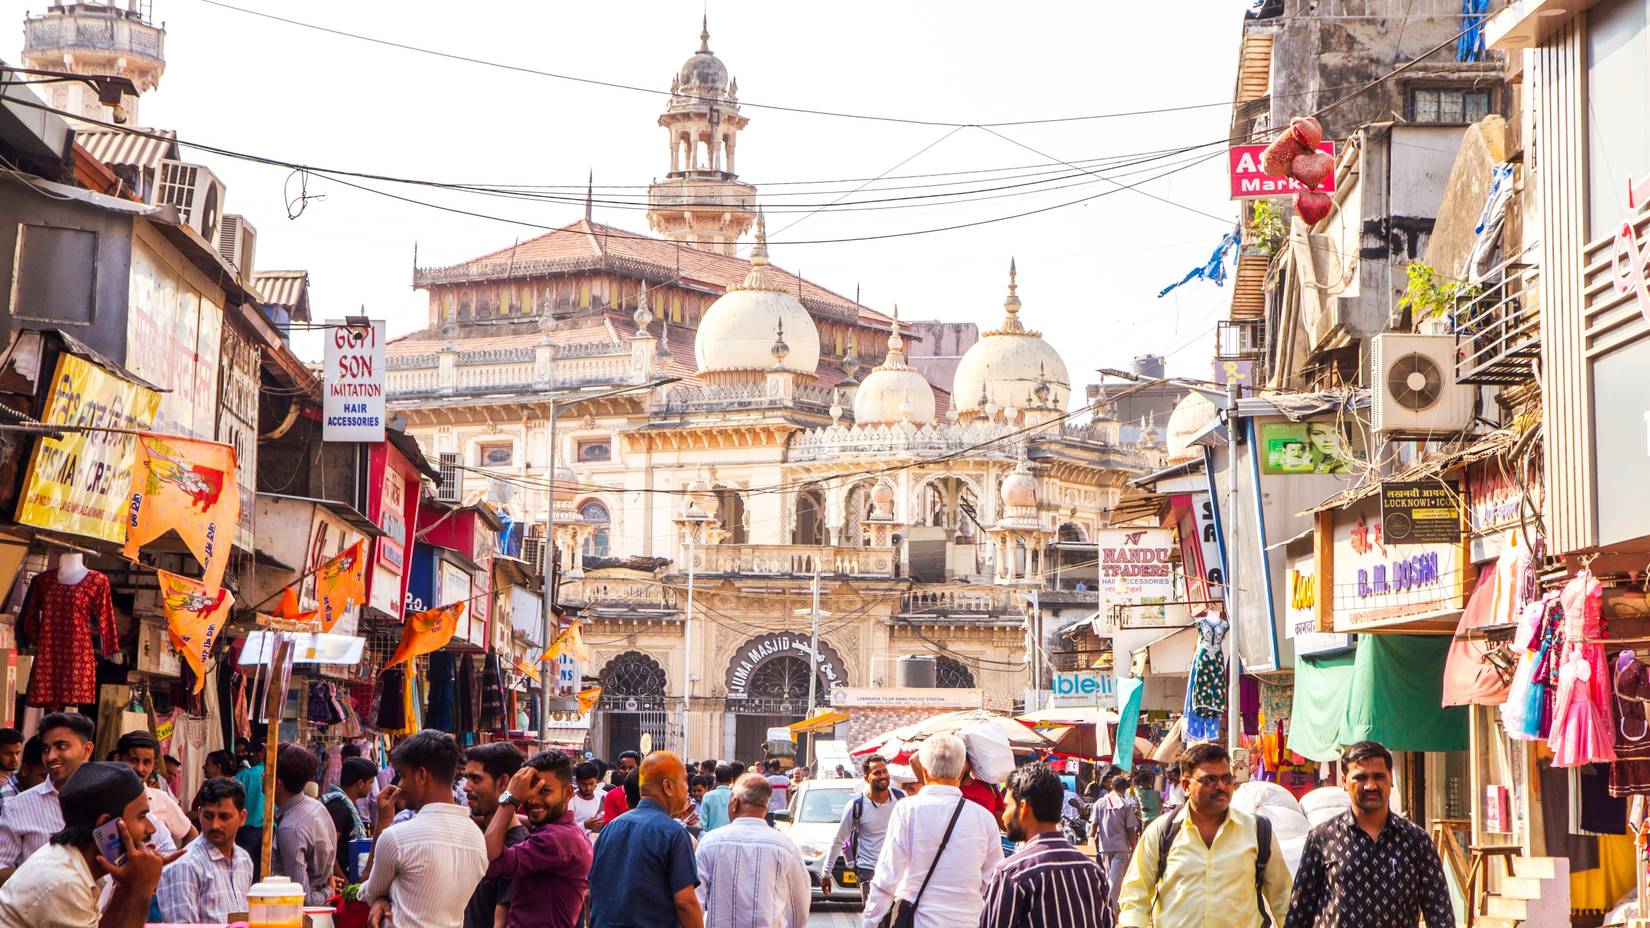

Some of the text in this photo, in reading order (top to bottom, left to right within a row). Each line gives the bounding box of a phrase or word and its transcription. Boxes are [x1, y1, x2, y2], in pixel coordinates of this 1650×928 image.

[1241, 178, 1325, 192] Mark
[339, 355, 373, 379] SON
[330, 384, 381, 397] IMITATION
[344, 404, 367, 413] HAIR
[327, 417, 379, 427] ACCESSORIES
[1383, 498, 1431, 508] LUCKNOWI
[1103, 548, 1168, 564] NANDU
[1102, 564, 1169, 578] TRADERS
[731, 637, 790, 693] JUMA MASJID
